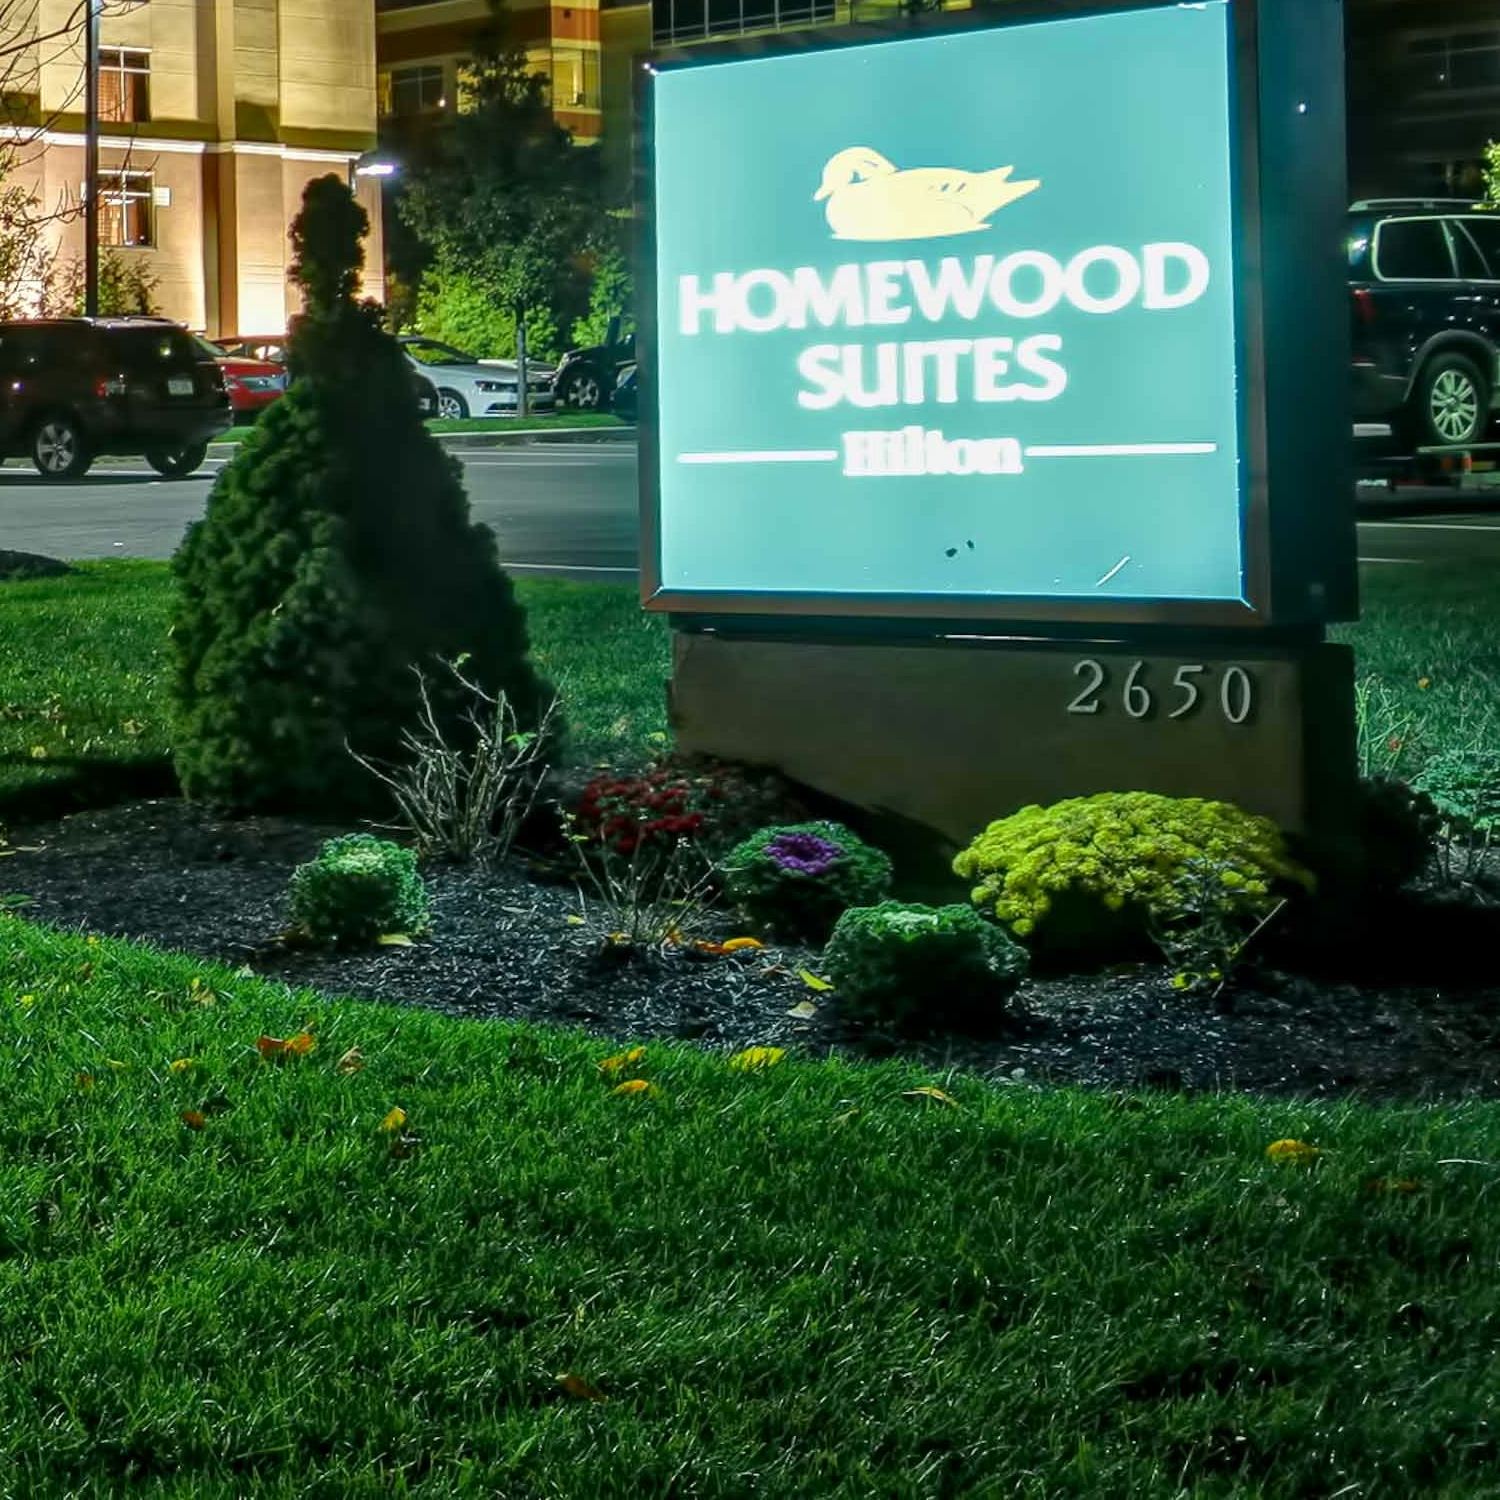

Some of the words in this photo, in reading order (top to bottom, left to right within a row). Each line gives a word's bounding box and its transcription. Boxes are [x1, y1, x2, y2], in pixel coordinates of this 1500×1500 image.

[679, 242, 1210, 335] HOMEWOOD
[797, 334, 1067, 409] SUITES
[842, 426, 1024, 476] Hilton
[1067, 659, 1251, 723] 2650
